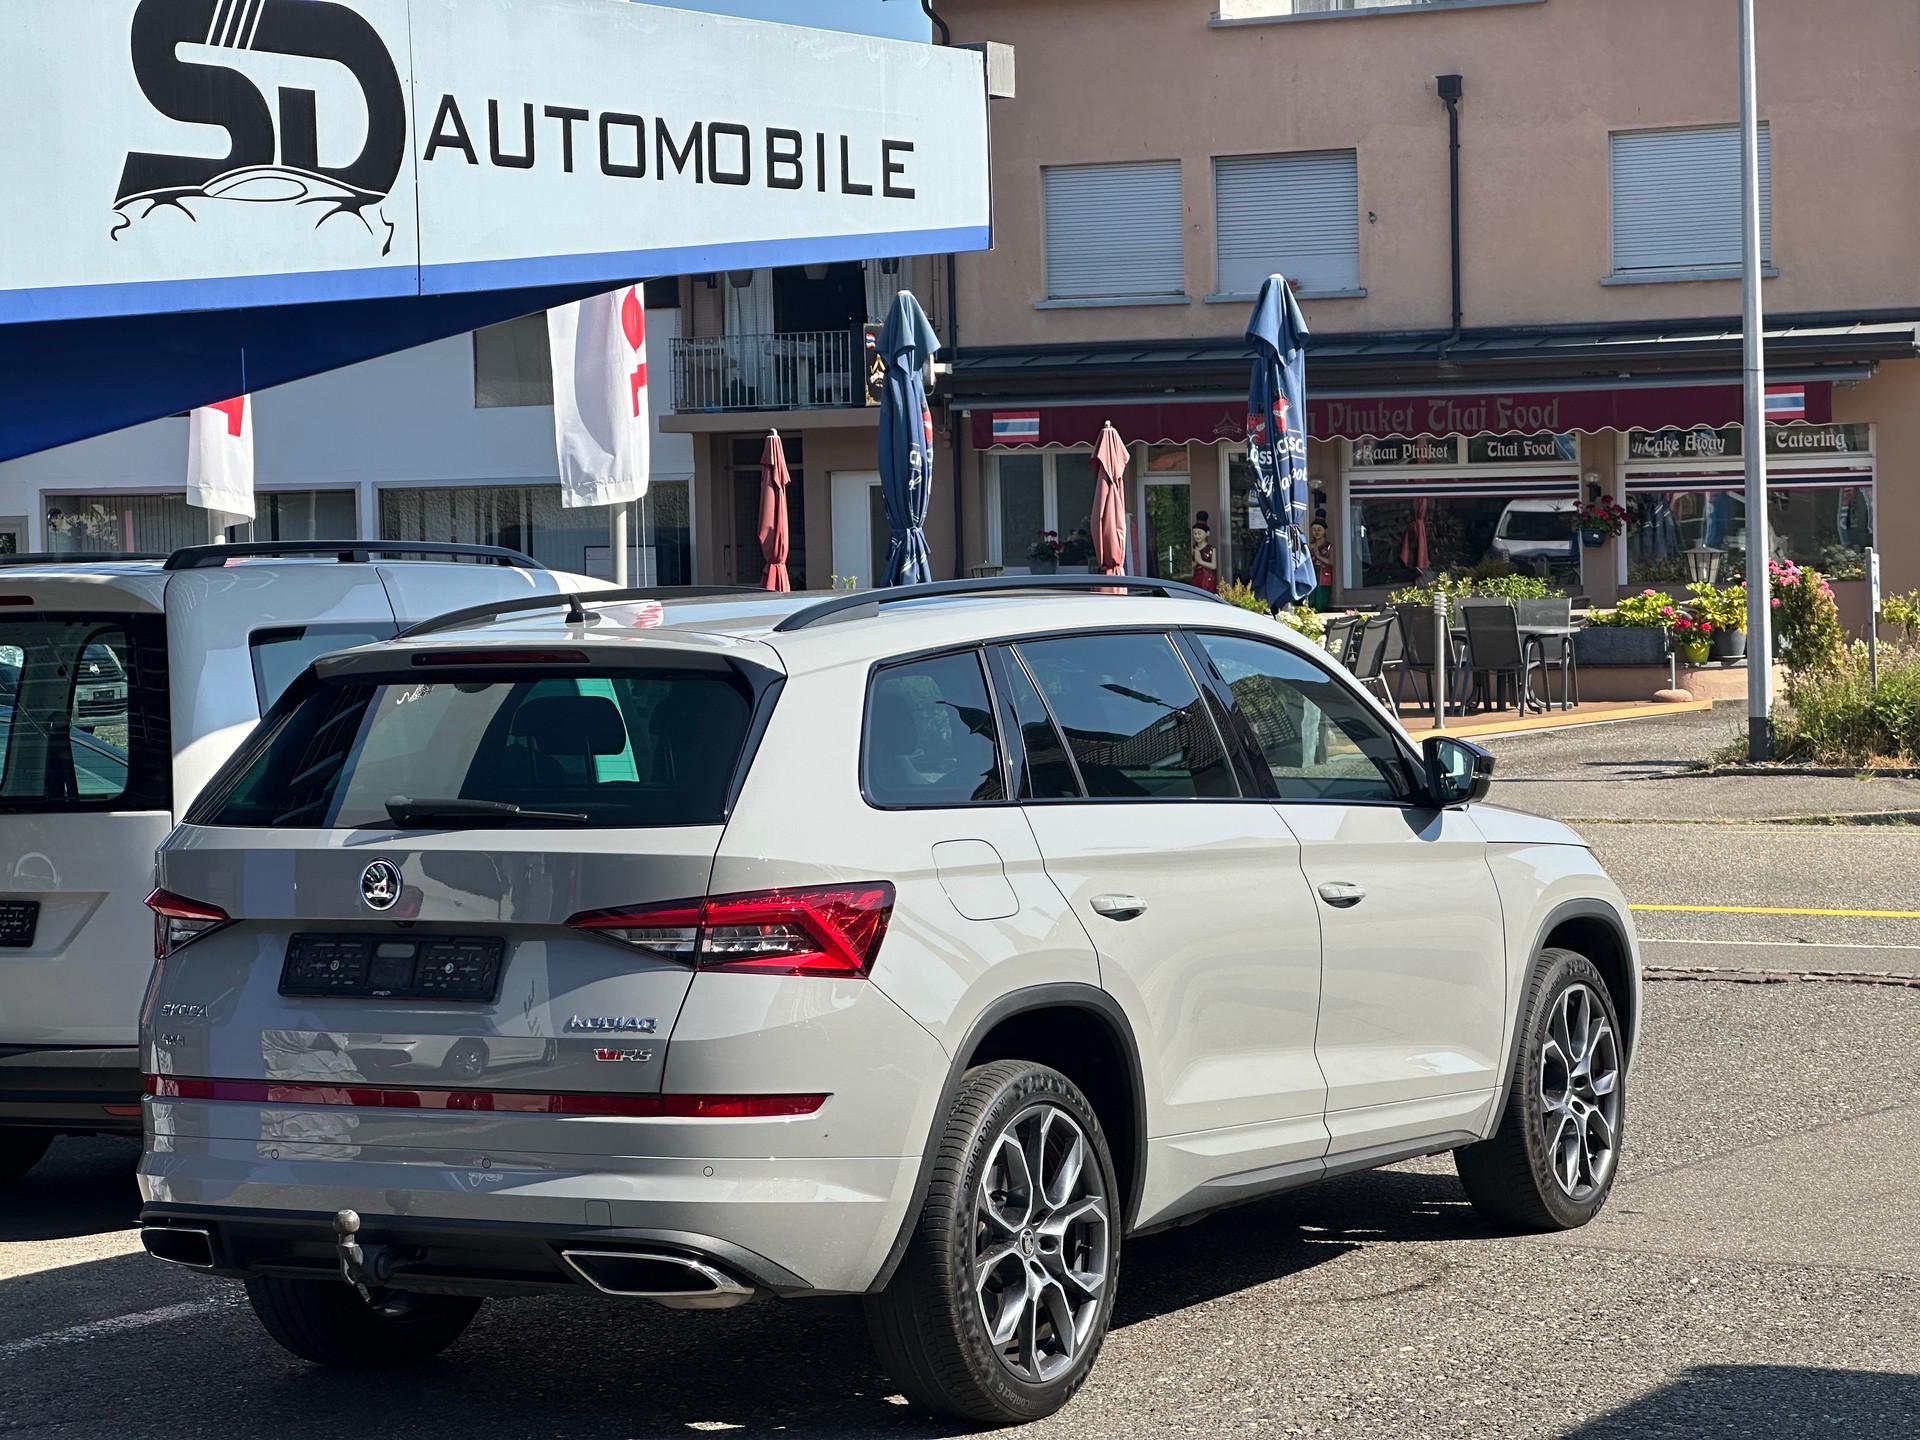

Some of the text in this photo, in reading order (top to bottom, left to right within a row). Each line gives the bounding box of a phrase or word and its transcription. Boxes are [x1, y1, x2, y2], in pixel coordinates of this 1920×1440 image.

[424, 93, 915, 199] AUTOMOBILE
[1327, 402, 1414, 434] Phuket
[1428, 399, 1487, 431] Thai
[1497, 397, 1560, 430] Food
[1487, 440, 1555, 457] Thai Food
[1644, 434, 1726, 453] Take Away
[1775, 431, 1848, 452] Catering
[1363, 443, 1448, 460] Baan Phuket
[570, 1014, 659, 1034] KODIAQ
[981, 1120, 993, 1137] 20
[977, 1135, 986, 1146] R
[963, 1145, 982, 1191] 235/45
